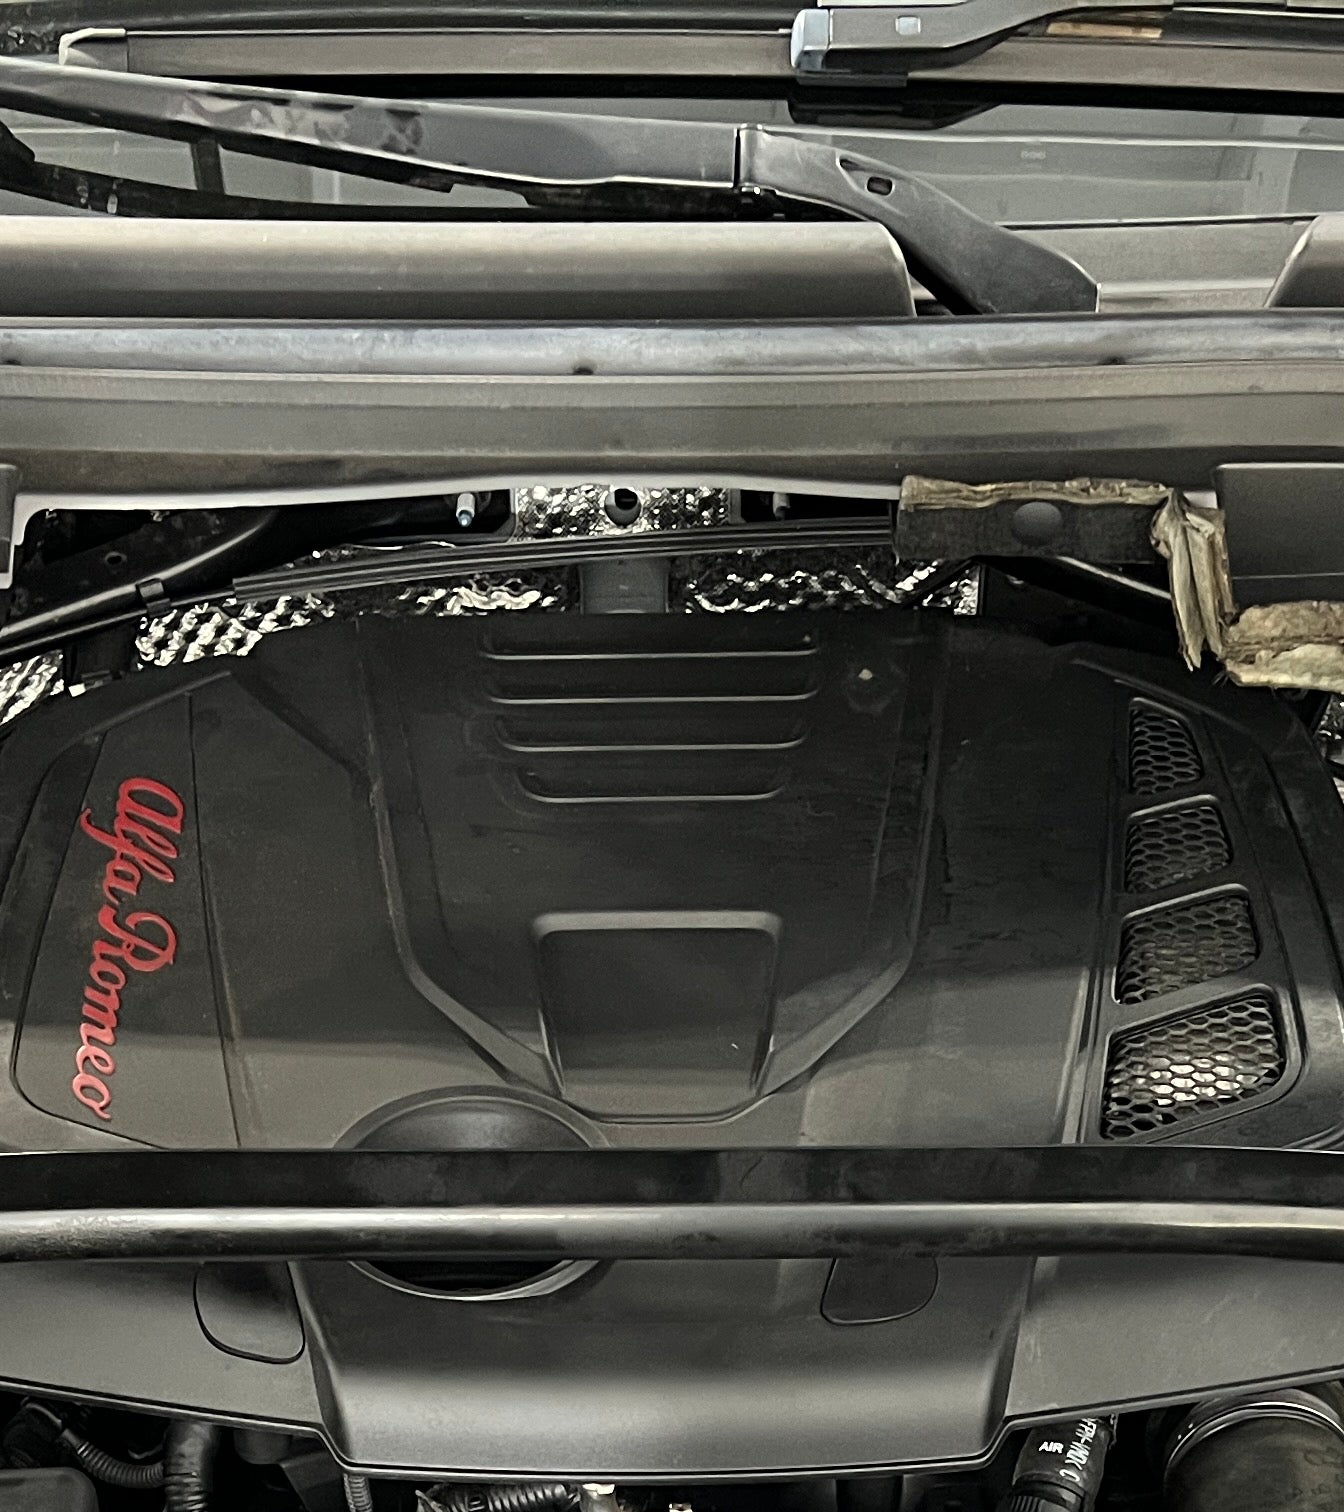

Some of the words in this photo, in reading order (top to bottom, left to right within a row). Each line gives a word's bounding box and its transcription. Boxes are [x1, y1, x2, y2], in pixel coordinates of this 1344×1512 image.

[80, 776, 185, 906] Alfa
[72, 903, 177, 1121] Romeo
[1038, 1441, 1064, 1454] AIR
